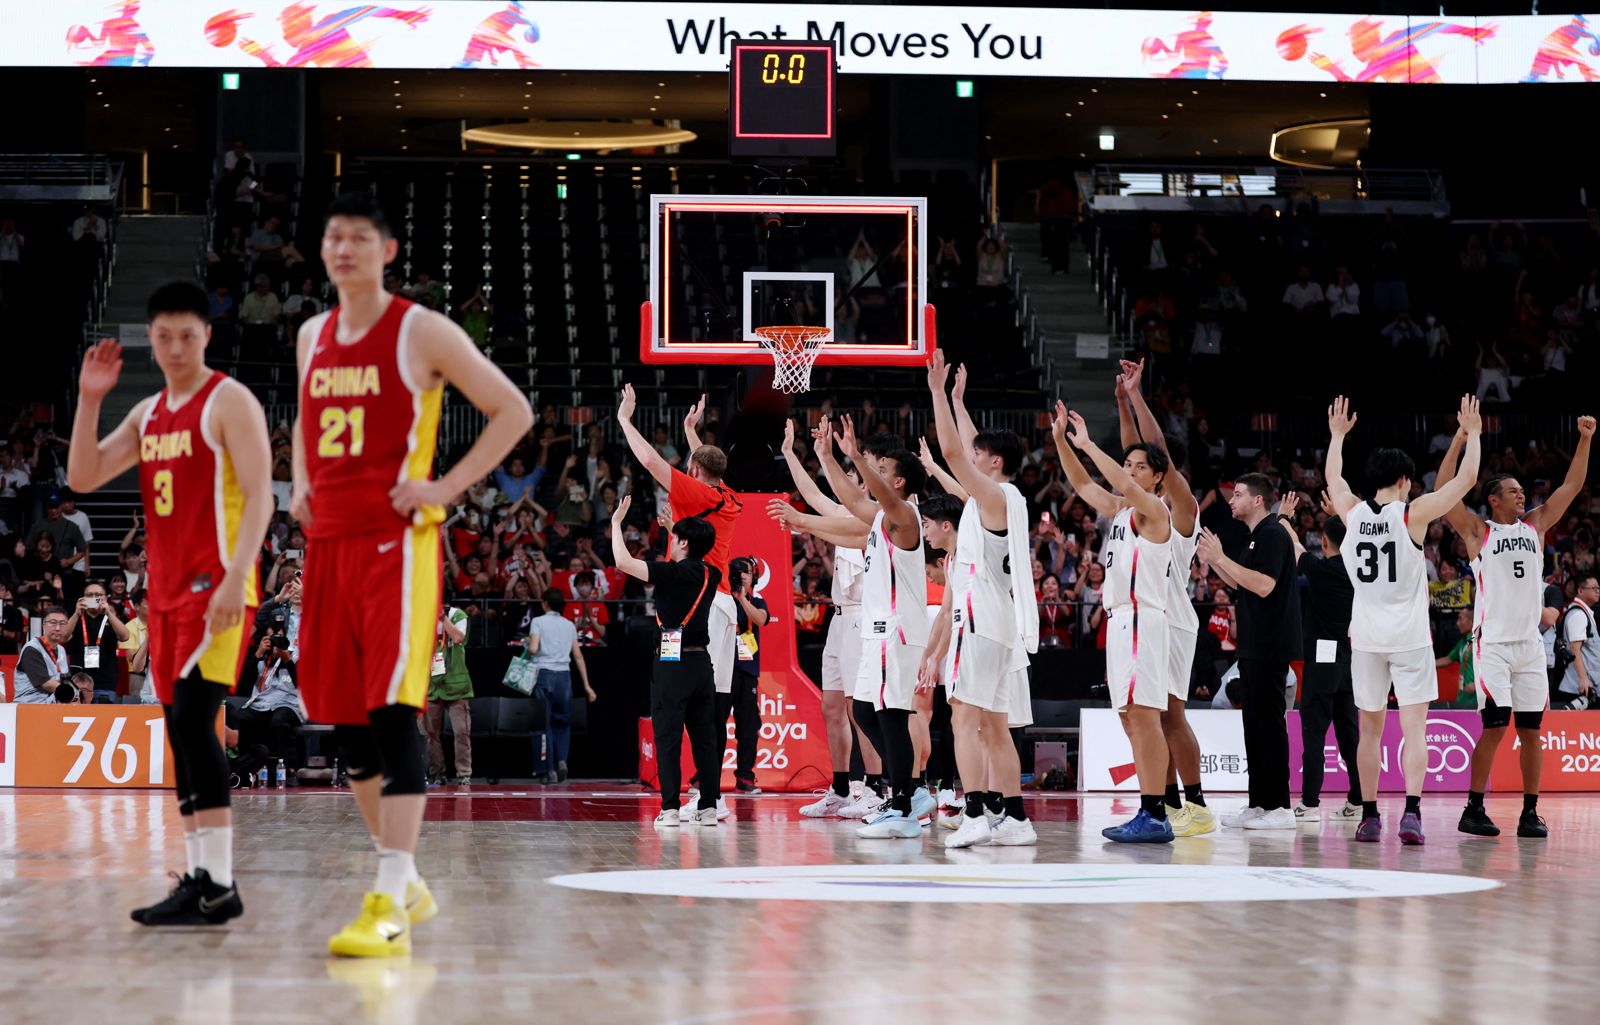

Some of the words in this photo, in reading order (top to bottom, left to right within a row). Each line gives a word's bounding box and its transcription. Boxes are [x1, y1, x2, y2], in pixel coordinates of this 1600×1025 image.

[807, 20, 949, 58] Moves
[961, 23, 1042, 60] You
[762, 54, 805, 84] 0.0
[310, 365, 380, 398] CHINA
[318, 406, 365, 457] 21
[153, 469, 174, 516] 3
[1360, 521, 1390, 536] OGAWA
[1356, 541, 1397, 583] 31
[1492, 536, 1537, 555] JAPAN
[1513, 561, 1525, 579] 5
[62, 717, 165, 784] 361
[722, 748, 789, 769] 226
